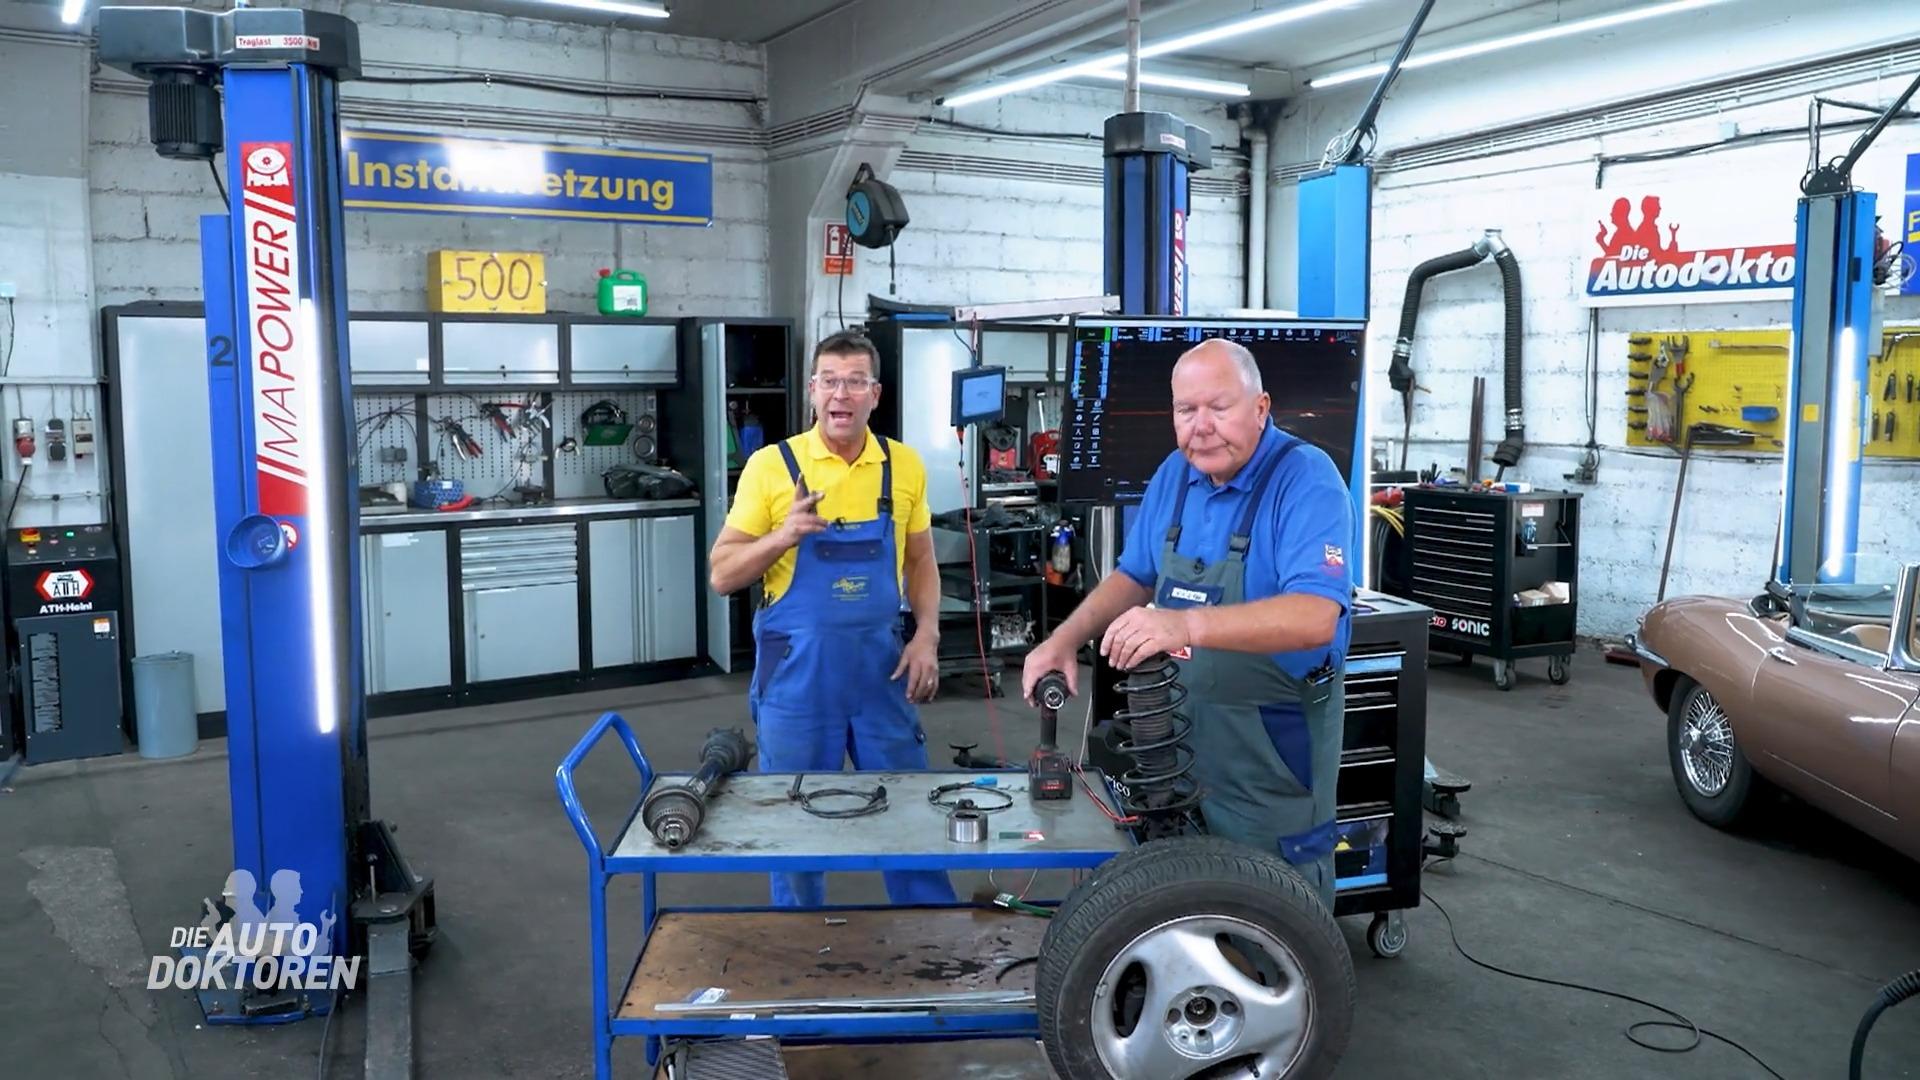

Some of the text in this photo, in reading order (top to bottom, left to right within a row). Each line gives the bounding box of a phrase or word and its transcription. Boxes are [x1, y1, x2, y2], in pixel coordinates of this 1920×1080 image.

[239, 38, 272, 48] Traglast
[348, 152, 674, 211] Instaetzung
[1620, 245, 1650, 262] Die
[455, 256, 533, 301] 500
[210, 336, 233, 367] 2
[1106, 775, 1130, 797] ico
